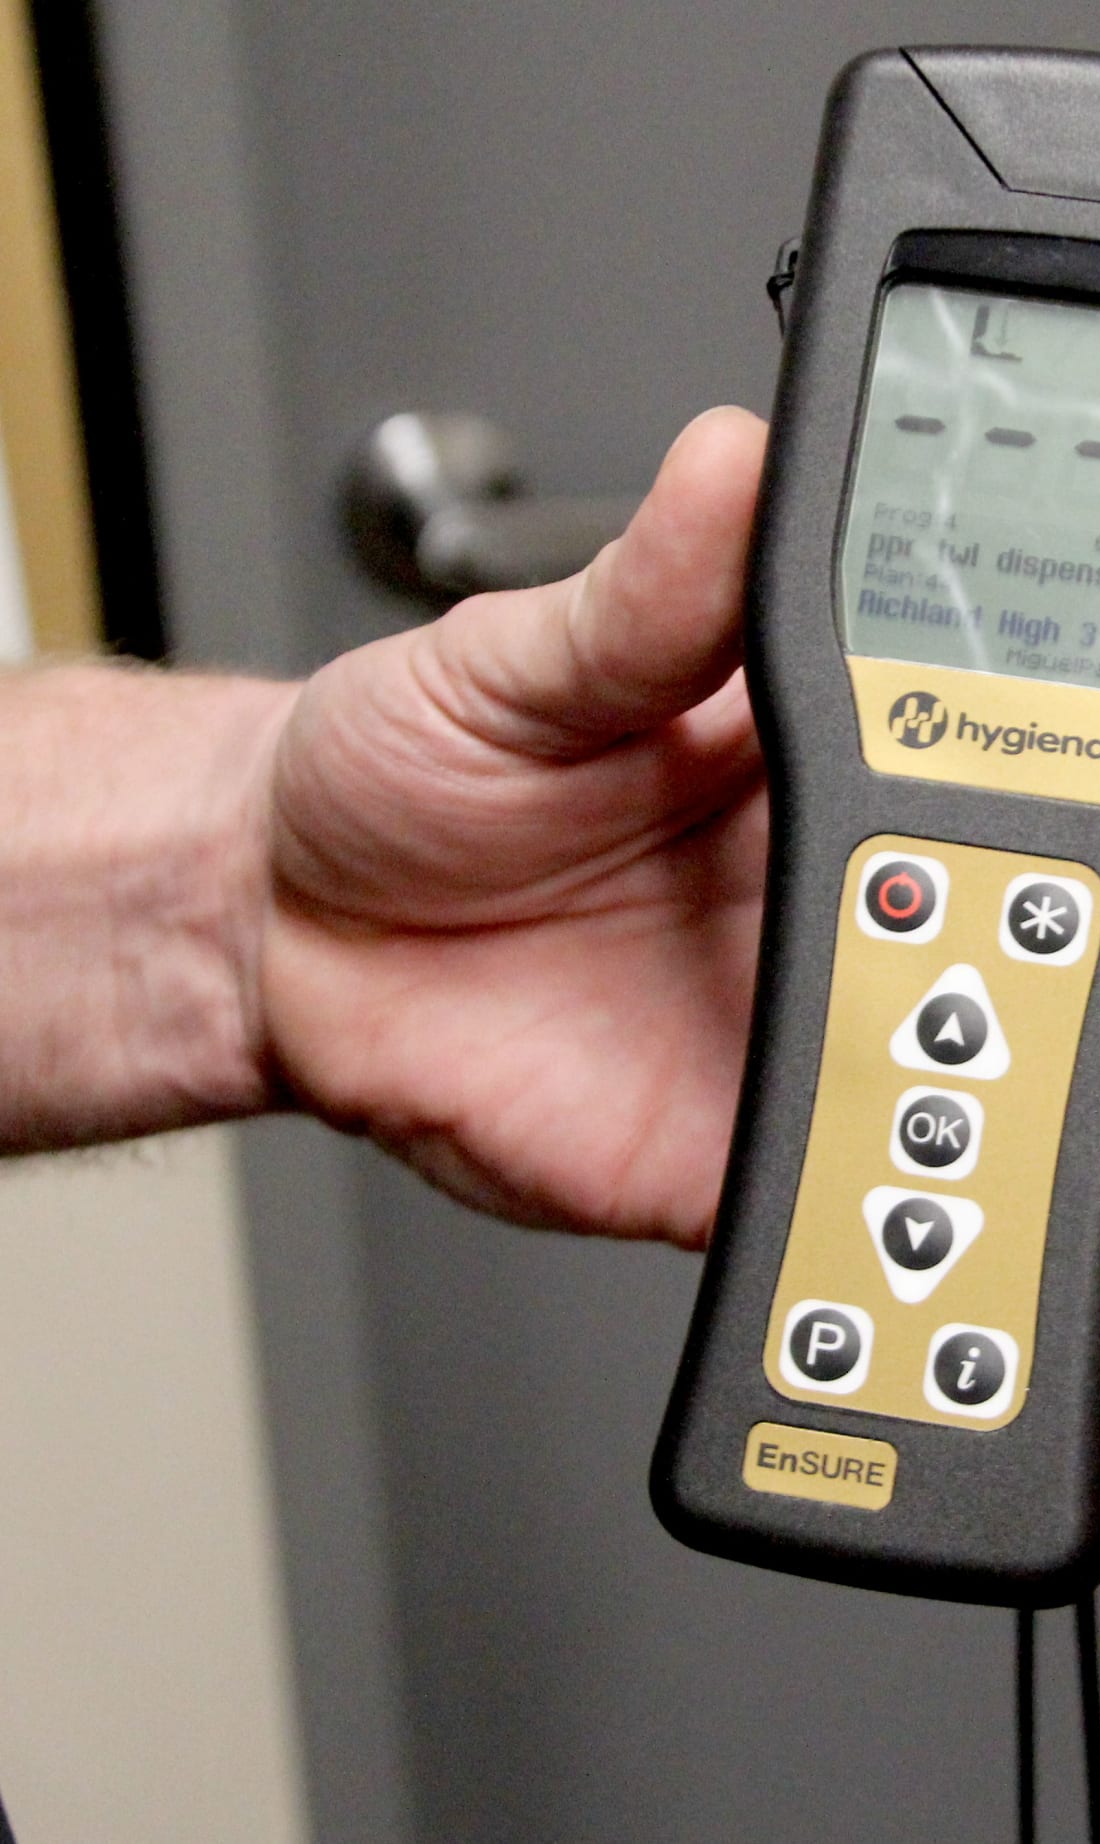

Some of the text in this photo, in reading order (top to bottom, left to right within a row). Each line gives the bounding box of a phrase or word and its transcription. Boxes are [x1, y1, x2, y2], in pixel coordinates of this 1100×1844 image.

[997, 609, 1062, 646] High
[1080, 621, 1098, 648] 3
[906, 1111, 964, 1149] OK
[805, 1320, 847, 1366] P
[956, 1346, 981, 1391] i
[756, 1442, 886, 1486] EnSURE
